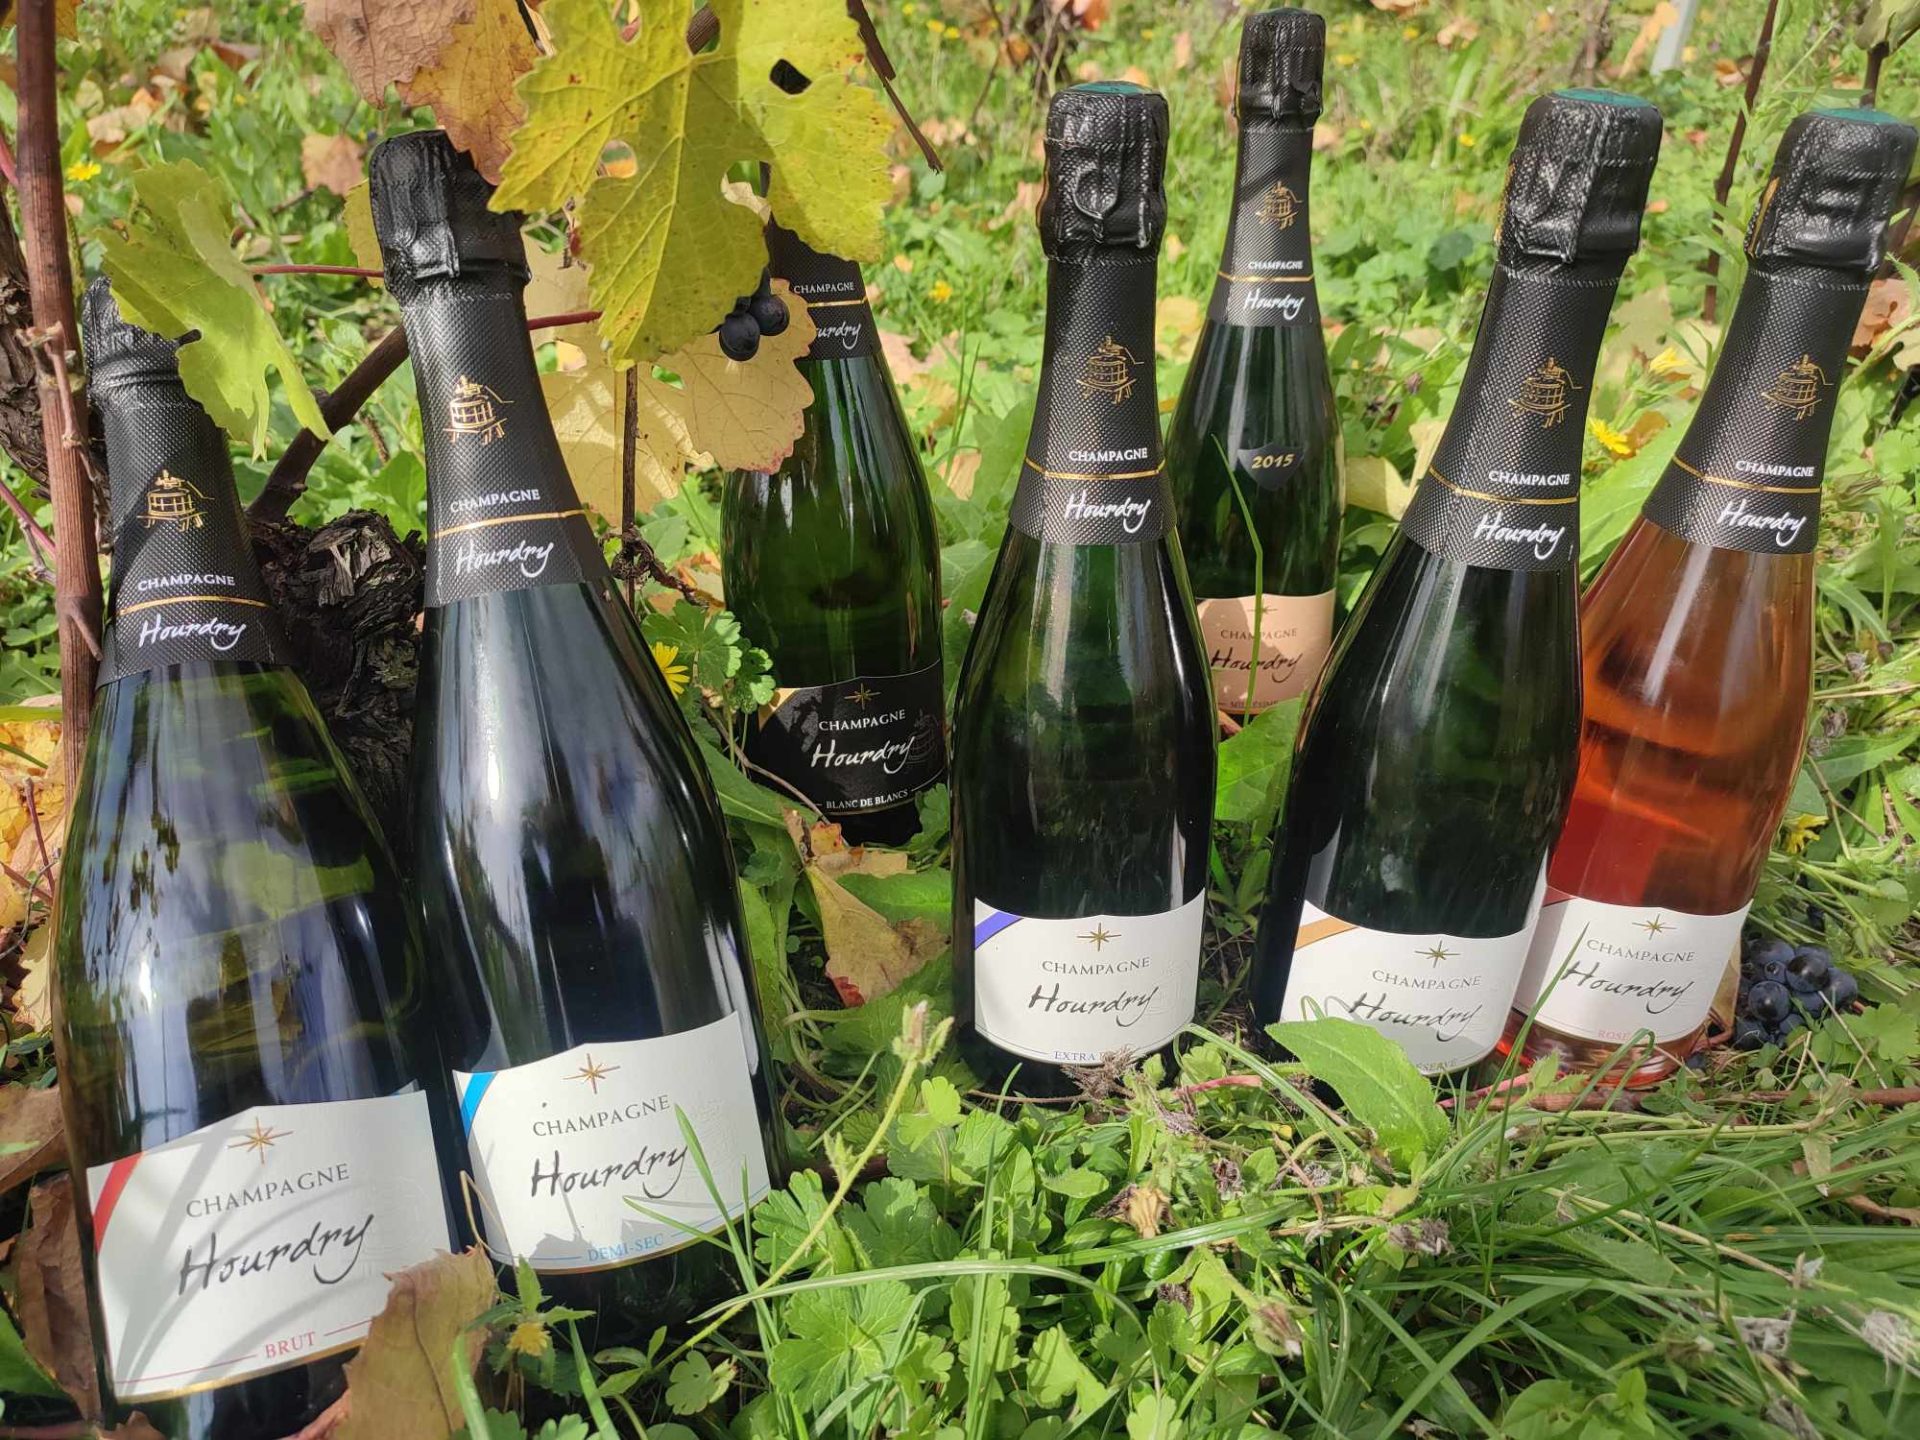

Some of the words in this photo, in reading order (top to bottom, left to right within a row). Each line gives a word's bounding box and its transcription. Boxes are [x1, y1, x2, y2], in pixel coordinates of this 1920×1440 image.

[1248, 260, 1303, 271] CHAMPAGNE
[793, 281, 855, 294] CHAMPAGNE
[1243, 289, 1305, 321] Hourdry
[816, 321, 861, 350] urdry
[1068, 447, 1148, 462] CHAMPAGNE
[1251, 453, 1295, 470] 2015
[1735, 460, 1815, 477] CHAMPAGNE
[1488, 470, 1571, 486] CHAMPAGNE
[450, 489, 541, 513] CHAMPAGNE
[1064, 490, 1151, 534] Hourdry
[1473, 510, 1566, 560] Hourdry
[1716, 499, 1807, 547] Hourdry
[456, 539, 554, 578] Hourdry
[138, 574, 236, 591] CHAMPAGNE
[138, 614, 247, 650] Hourdry
[818, 708, 906, 731] CHAMPAGNE
[810, 736, 916, 775] Hourdry
[826, 800, 858, 809] BLANC
[860, 798, 873, 807] DE
[875, 789, 909, 804] BLANCS
[1586, 939, 1696, 963] CHAMPAGNE
[1042, 956, 1150, 976] CHAMPAGNE
[1372, 969, 1482, 990] CHAMPAGNE
[1560, 960, 1696, 1015] Hourdry
[1028, 983, 1159, 1027] Hourdry
[1349, 992, 1483, 1042] Hourdry
[1054, 1051, 1096, 1061] EXTRA
[531, 1094, 671, 1137] CHAMPAGNE
[530, 1145, 689, 1199] Hourdry
[186, 1162, 351, 1218] CHAMPAGNE
[178, 1214, 375, 1296] Hourdry
[587, 1232, 665, 1263] DEMI-SEC
[264, 1331, 316, 1359] BRUT
